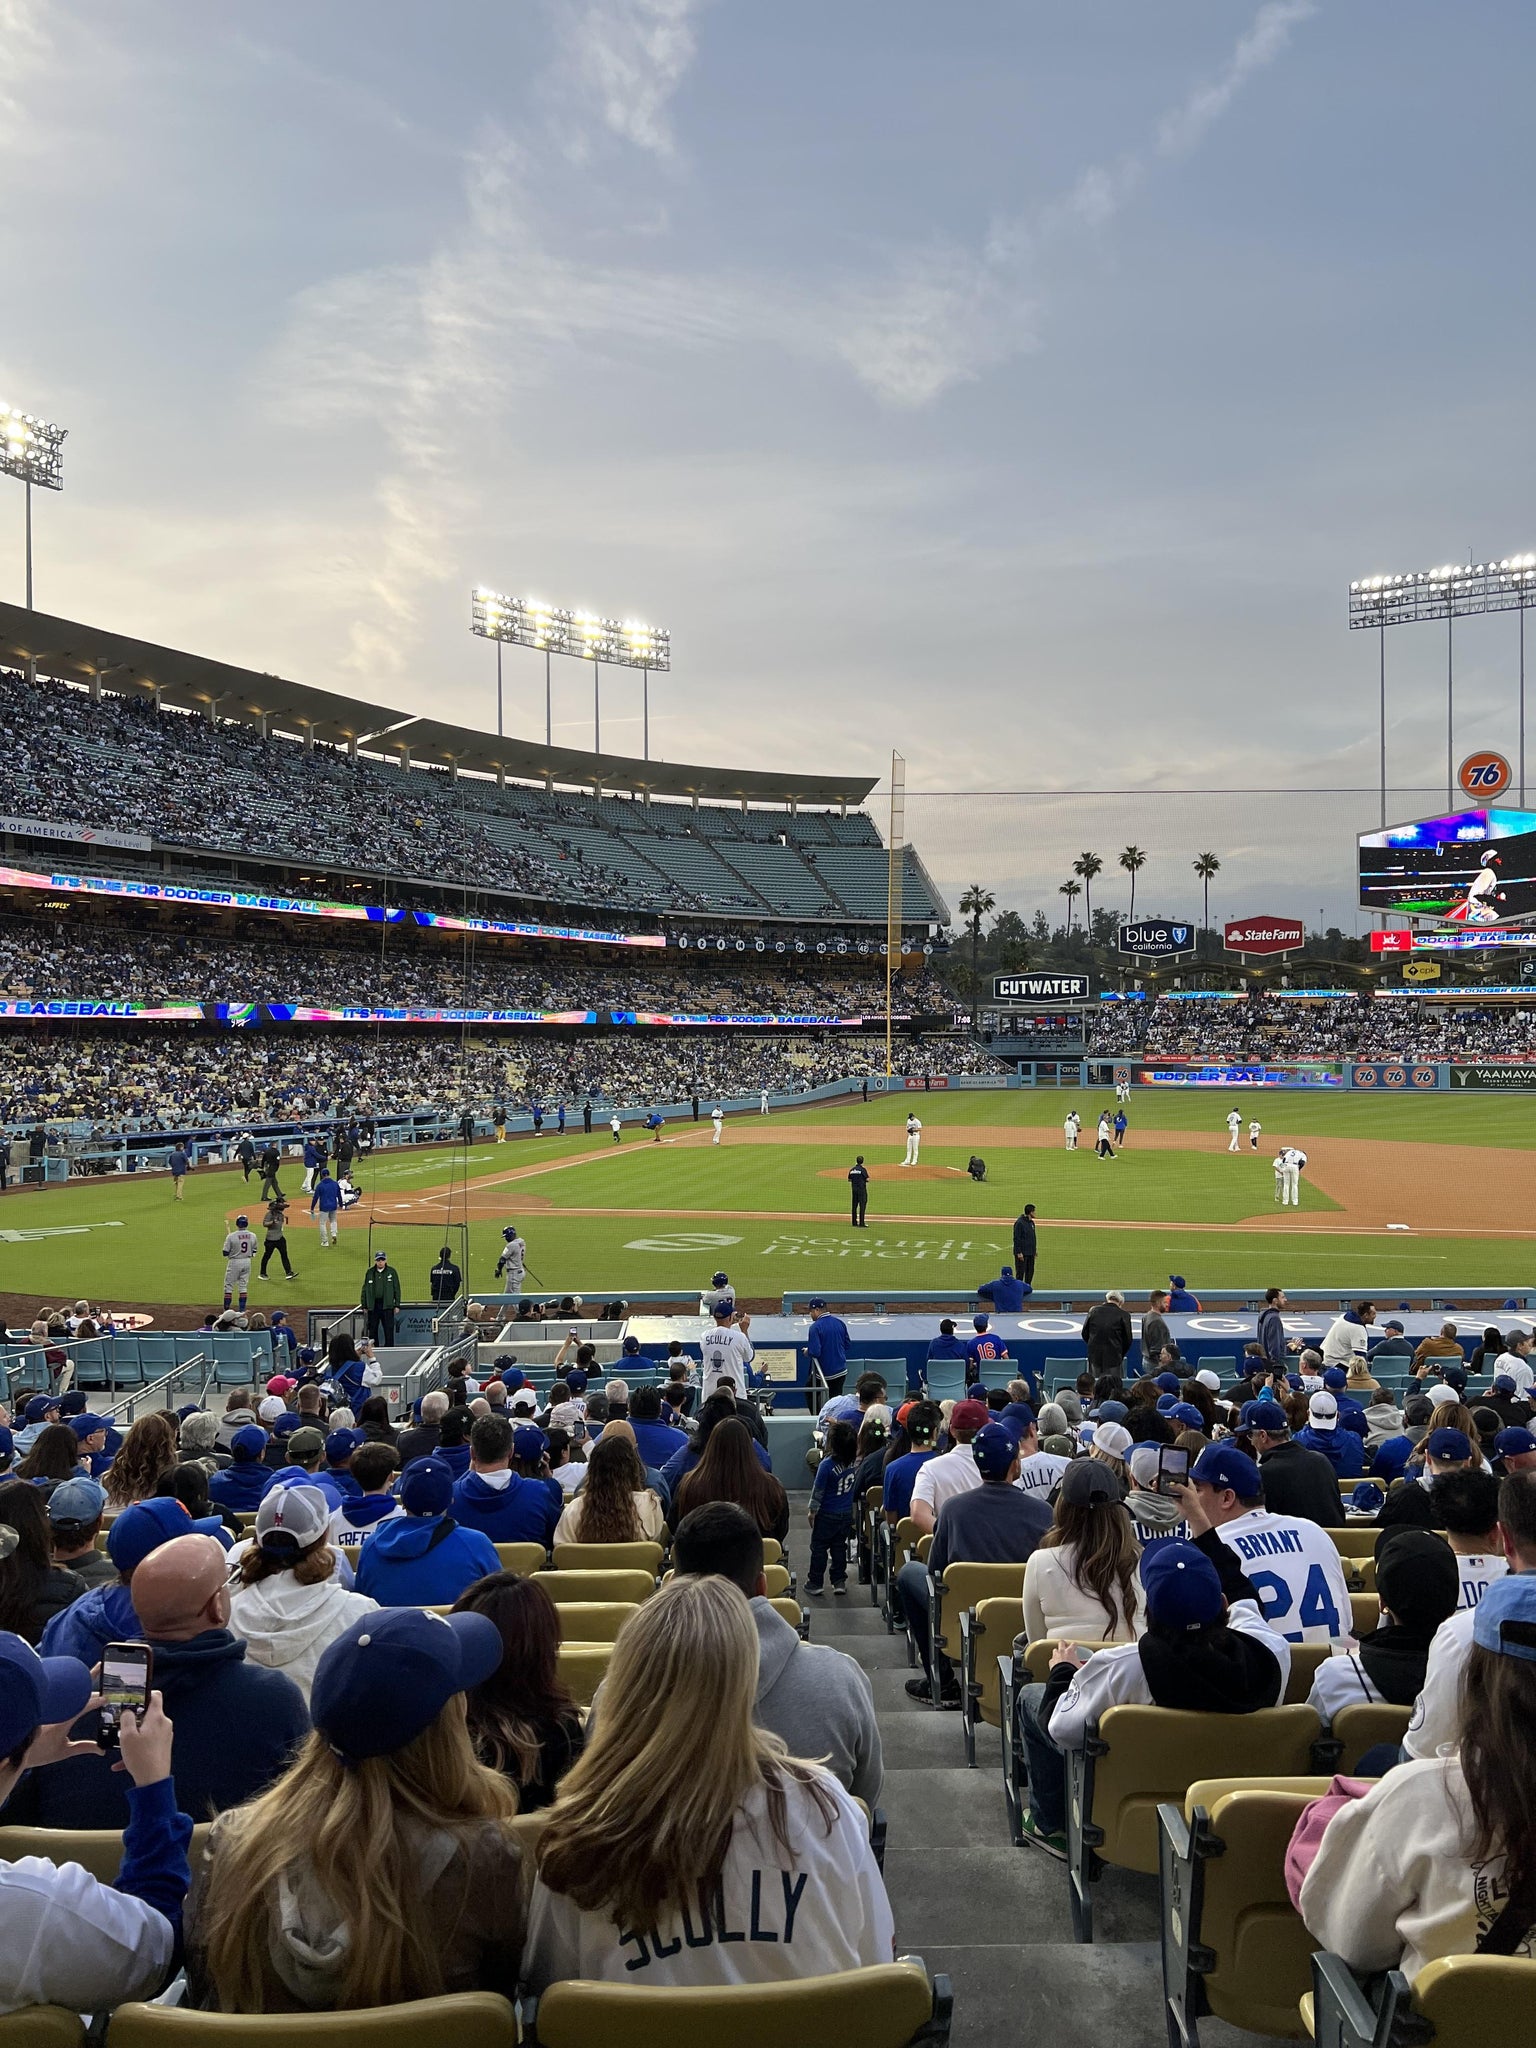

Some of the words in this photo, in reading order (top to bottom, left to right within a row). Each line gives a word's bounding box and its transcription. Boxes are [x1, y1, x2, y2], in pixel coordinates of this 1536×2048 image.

[1468, 762, 1501, 788] 76
[9, 823, 23, 833] OF
[26, 826, 74, 840] AMERICA
[104, 836, 123, 846] Suite
[124, 838, 142, 849] Level
[51, 874, 81, 888] IT'S
[86, 878, 123, 892] TIME
[126, 882, 160, 896] FOR
[164, 887, 232, 904] DODGER
[236, 893, 320, 914] BASEBALL
[469, 920, 489, 929] IT'S
[492, 922, 516, 932] TIME
[519, 924, 538, 933] FOR
[542, 926, 580, 938] DODGER
[583, 930, 628, 942] BASEBALL
[1126, 927, 1168, 942] blue
[1417, 936, 1474, 944] DODGER
[1420, 966, 1436, 974] cpk
[1000, 980, 1081, 995] CUTWATER
[16, 1001, 138, 1016] BASEBALL
[343, 1008, 370, 1018] IT'S
[374, 1008, 407, 1019] TIME
[411, 1009, 440, 1019] FOR
[441, 1010, 488, 1020] DODGER
[492, 1010, 544, 1021] BASEBALL
[1116, 1068, 1128, 1079] 76
[1154, 1072, 1220, 1081] DODGER
[1359, 1070, 1374, 1082] 76
[1387, 1070, 1402, 1082] 76
[1416, 1070, 1431, 1082] 76
[241, 1242, 248, 1253] 9
[772, 1234, 1014, 1254] Security
[760, 1244, 970, 1261] Benefit
[706, 1334, 734, 1346] SCULLY
[977, 1342, 997, 1360] 16
[1234, 1530, 1304, 1560] BRYANT
[1248, 1564, 1340, 1644] 24
